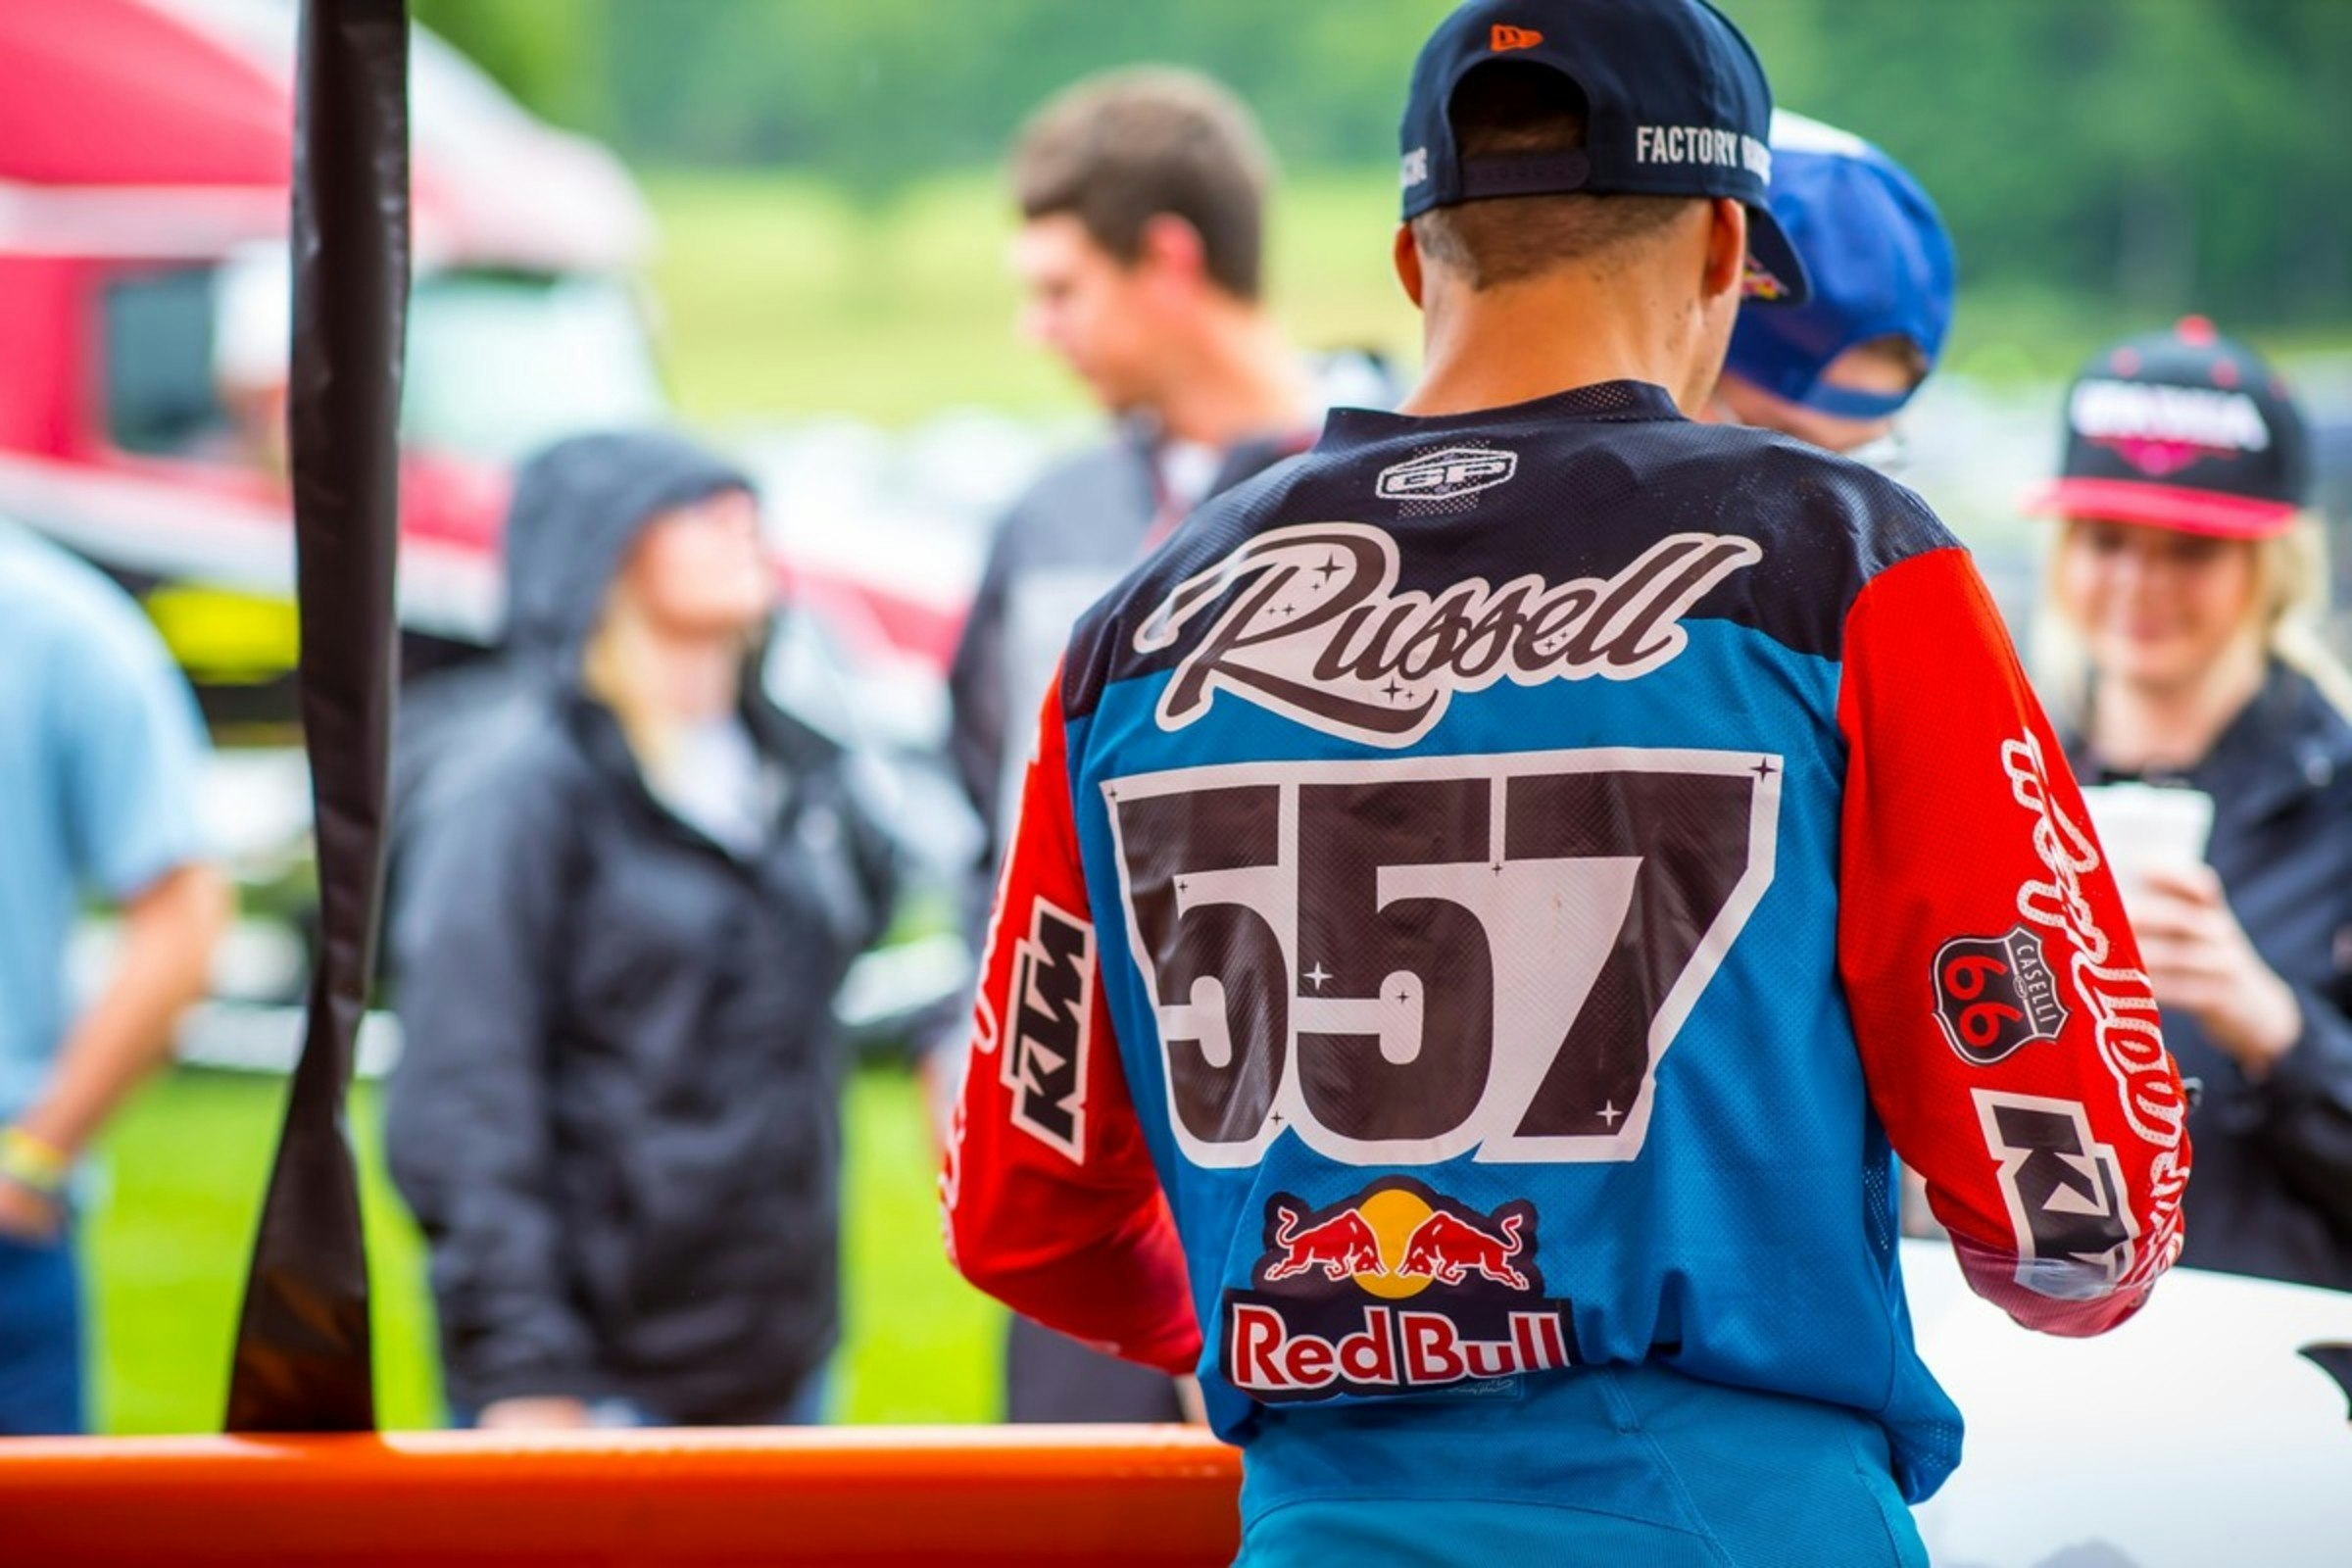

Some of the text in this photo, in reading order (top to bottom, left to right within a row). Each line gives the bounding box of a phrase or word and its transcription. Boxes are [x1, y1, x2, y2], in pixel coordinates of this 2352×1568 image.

[1637, 125, 1738, 168] FACTORY
[1135, 524, 1761, 746] Russell
[1111, 766, 1759, 1147] 557
[1943, 955, 2024, 1048] 66
[2015, 944, 2058, 1023] CASELLI
[1008, 906, 1090, 1151] KTM
[1232, 1303, 1570, 1390] Red Bull
